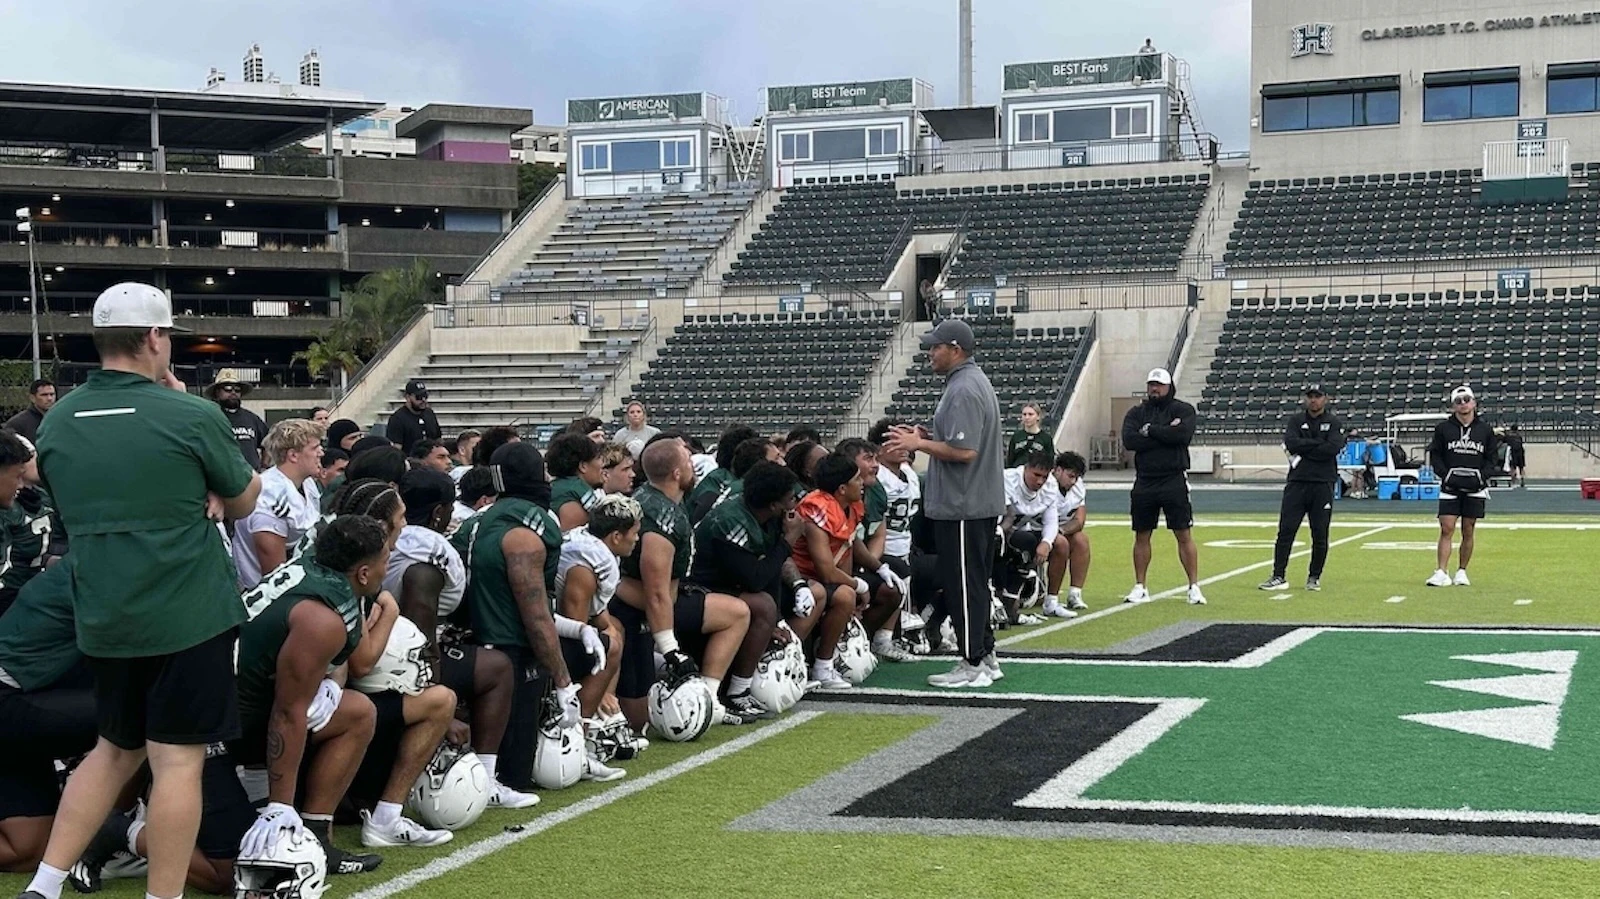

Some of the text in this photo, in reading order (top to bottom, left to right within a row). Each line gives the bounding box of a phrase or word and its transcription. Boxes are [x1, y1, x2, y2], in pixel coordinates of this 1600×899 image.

[1360, 23, 1446, 41] CLARENCE
[1450, 21, 1479, 34] T.C.
[1484, 17, 1534, 32] CHING
[1053, 62, 1108, 76] BEST Fans
[811, 86, 867, 99] BEST Team
[616, 99, 669, 111] AMERICAN
[1522, 127, 1543, 137] 202
[1503, 278, 1525, 289] 103
[973, 296, 991, 306] 102
